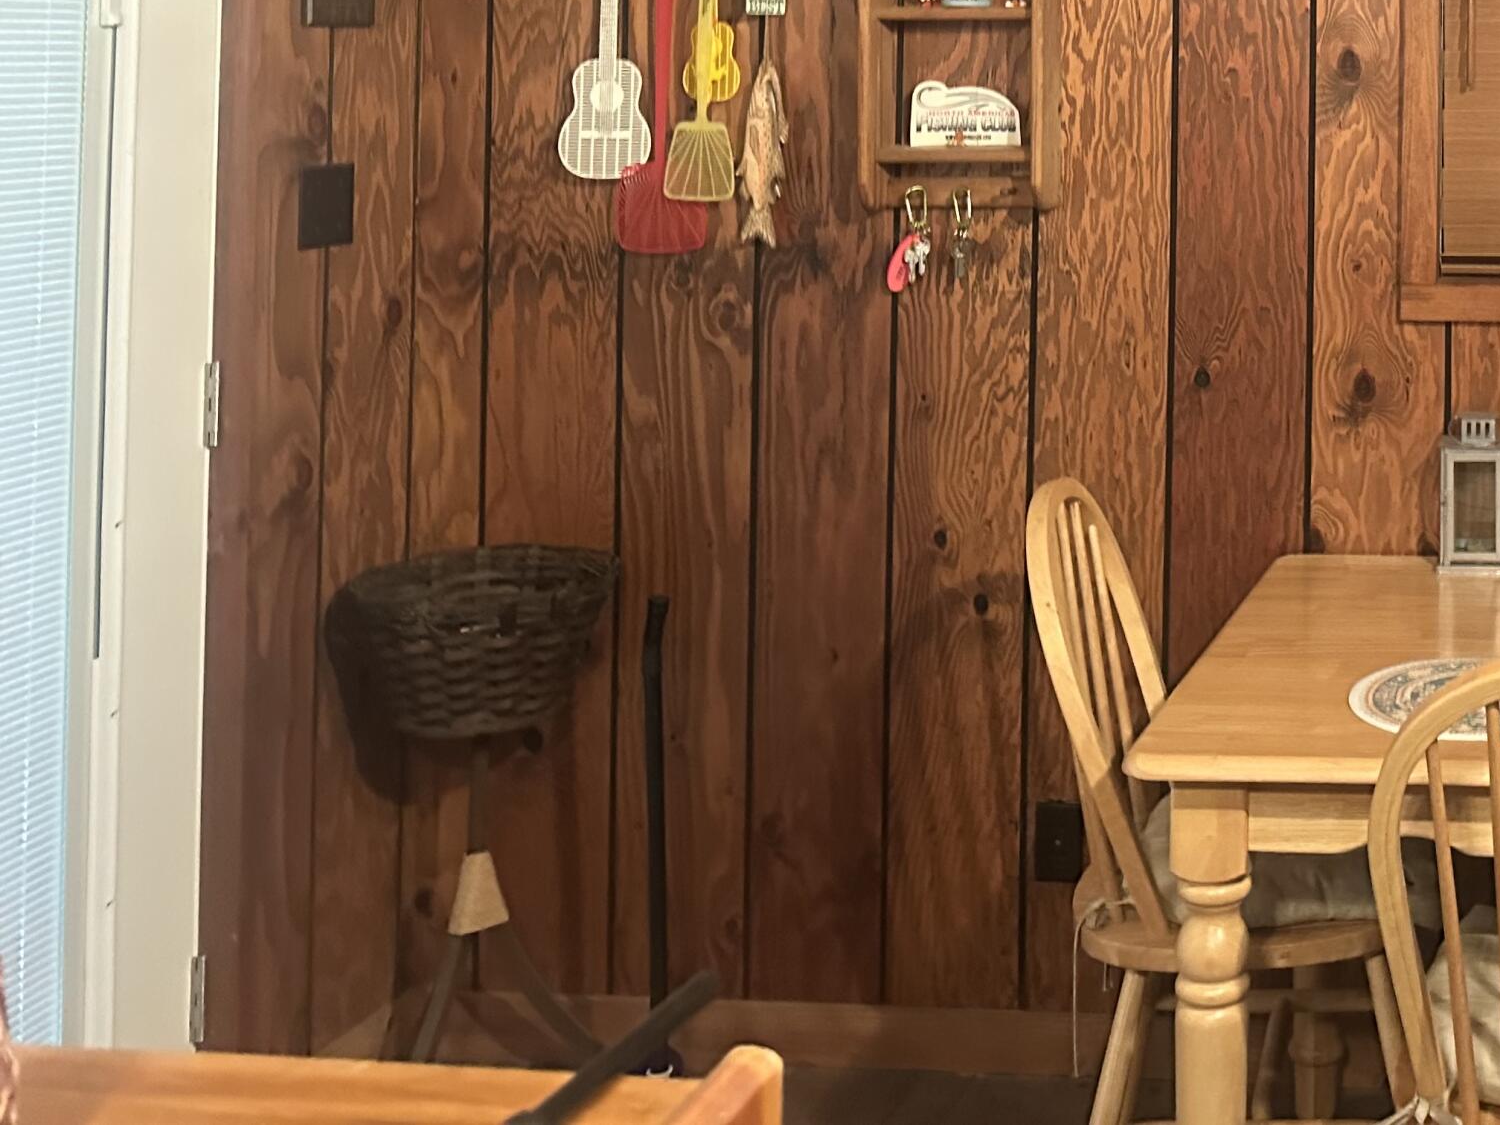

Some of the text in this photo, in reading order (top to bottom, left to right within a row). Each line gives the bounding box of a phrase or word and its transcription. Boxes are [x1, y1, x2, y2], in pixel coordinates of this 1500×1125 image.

[748, 2, 784, 15] BEST
[916, 115, 1017, 132] FISHING CLUB
